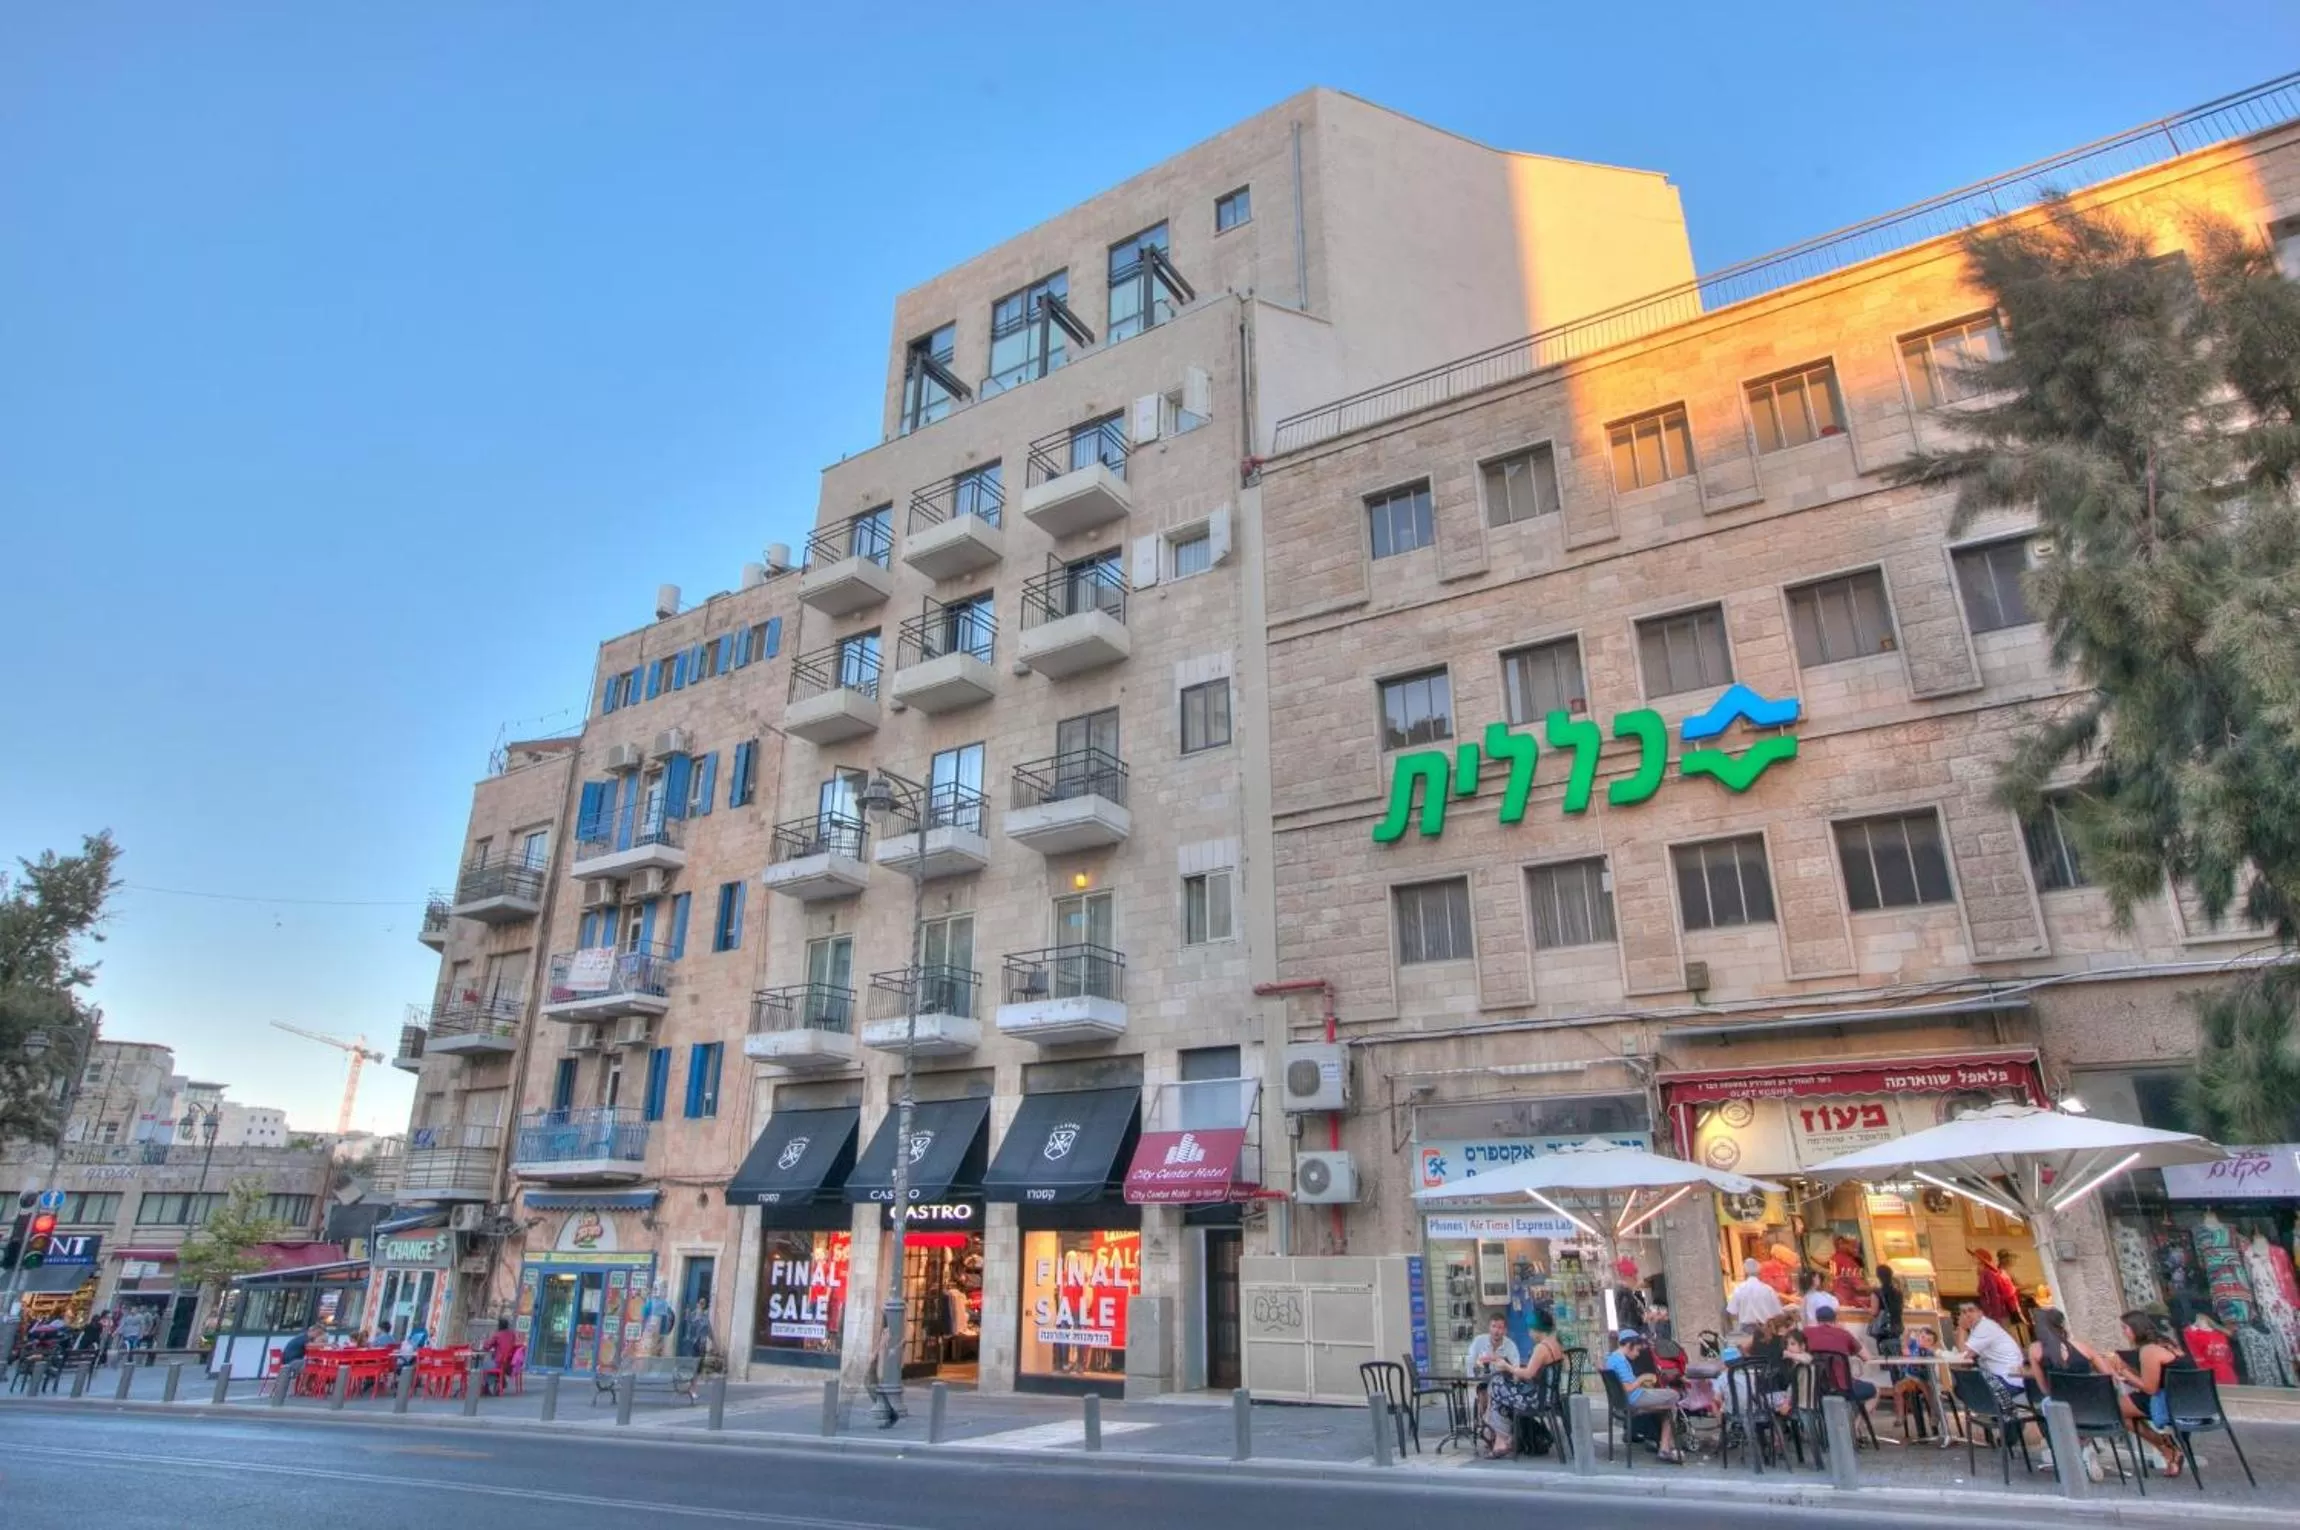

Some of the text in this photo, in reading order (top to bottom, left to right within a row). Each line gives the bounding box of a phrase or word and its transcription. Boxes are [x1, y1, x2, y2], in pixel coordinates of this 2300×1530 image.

[1371, 707, 1668, 843] כללית
[1884, 1069, 2009, 1088] פלאפל שווארמה
[1799, 1102, 1889, 1134] מעוז
[1464, 1143, 1535, 1164] אקספרס
[1132, 1167, 1228, 1181] City Center Hotel
[870, 1189, 920, 1201] CASO
[1026, 1188, 1056, 1201] קסטרו
[1131, 1190, 1146, 1200] City
[1429, 1217, 1574, 1232] Phones Air Time Express Lab
[385, 1240, 434, 1260] CHANGE
[770, 1260, 841, 1287] FINAL
[1035, 1258, 1130, 1287] FINAL
[768, 1293, 828, 1321] SALE
[1034, 1296, 1116, 1329] SALE
